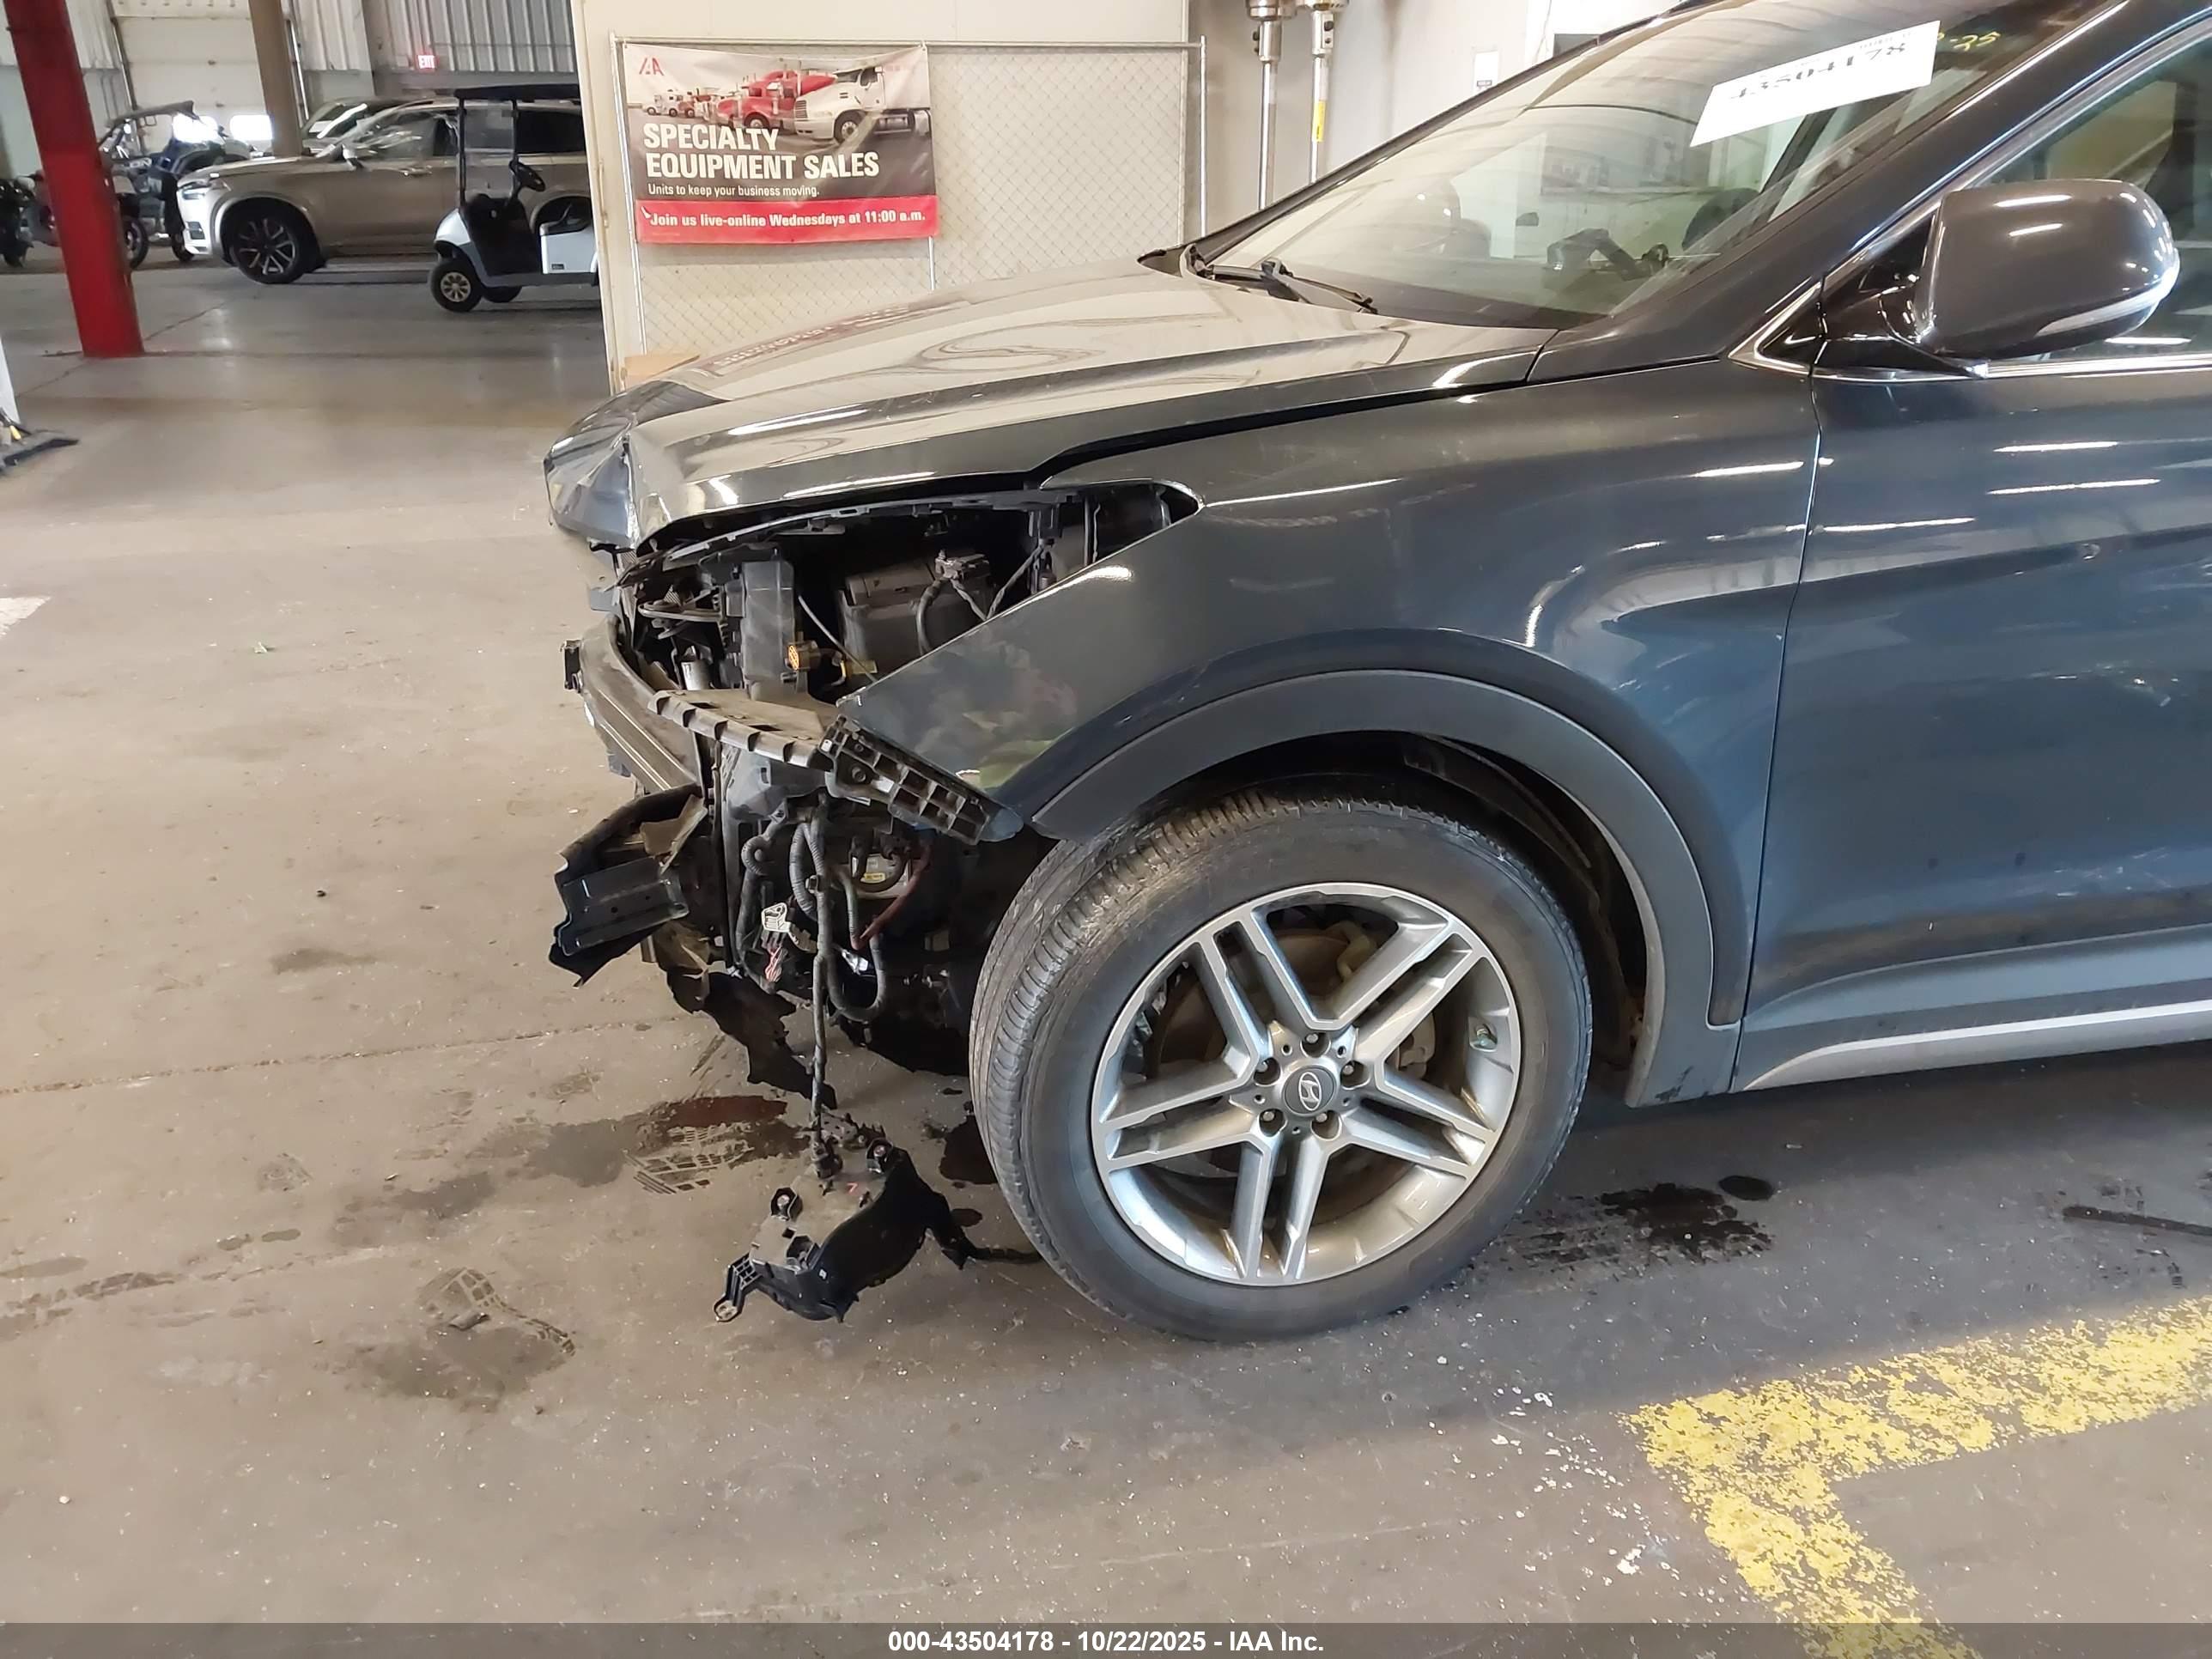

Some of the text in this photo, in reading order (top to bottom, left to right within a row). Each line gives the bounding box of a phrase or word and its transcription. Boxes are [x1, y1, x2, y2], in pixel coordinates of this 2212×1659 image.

[644, 123, 779, 151] SPECIALTY
[646, 151, 880, 179] EQUIPMENT SALES
[647, 183, 820, 198] Units to keep your business moving.
[650, 210, 926, 228] Join us live-online Wednesdays at 11:00 a.m.
